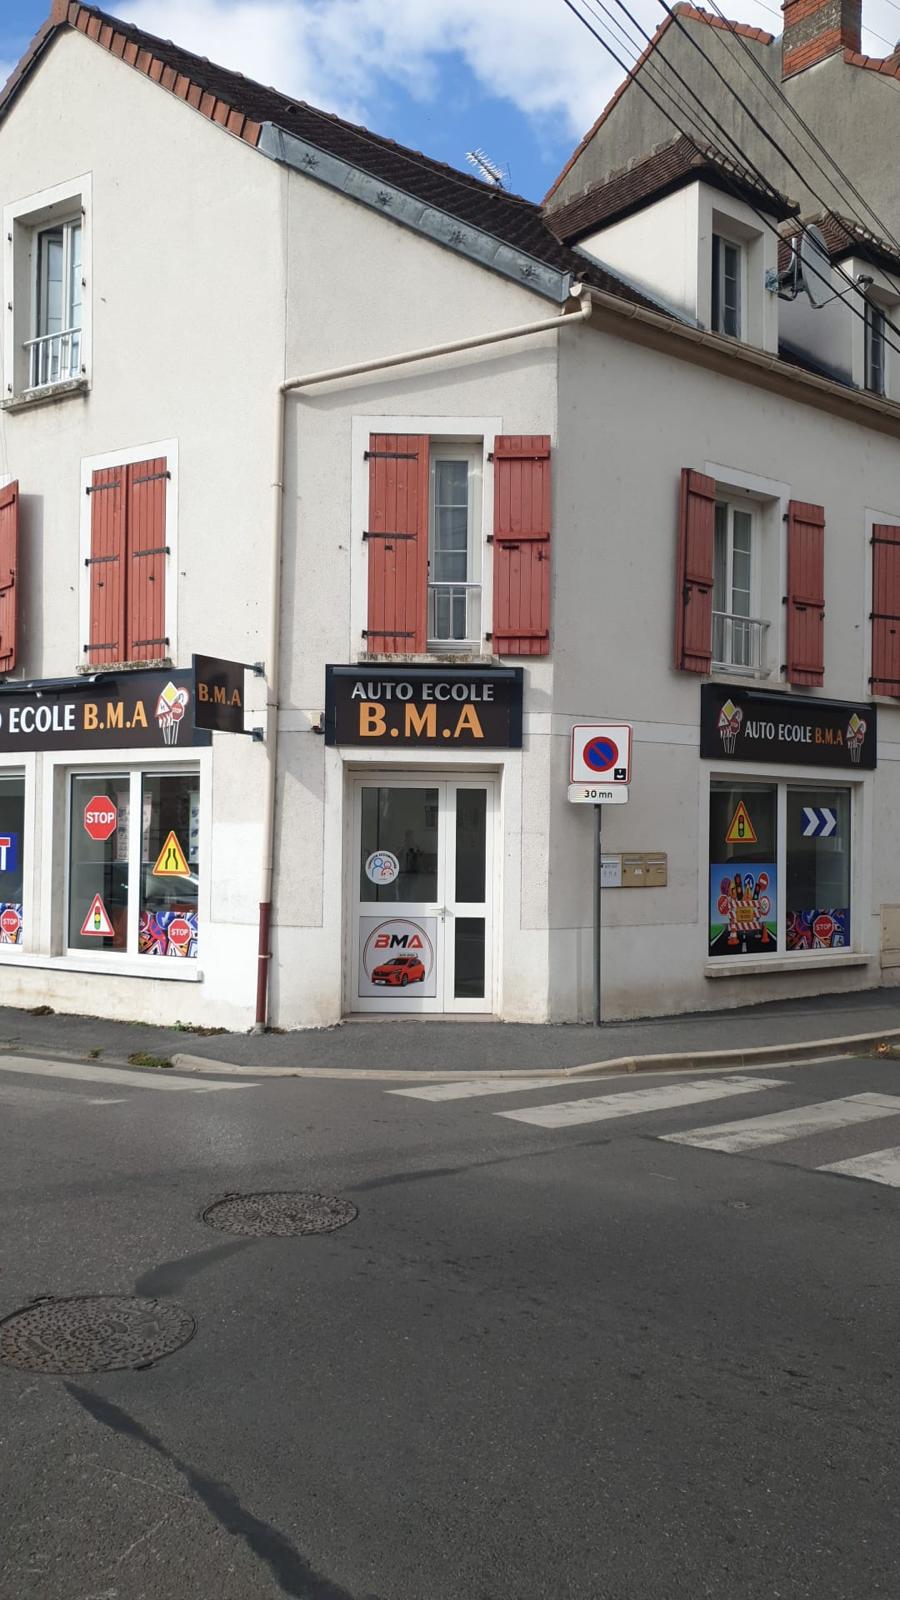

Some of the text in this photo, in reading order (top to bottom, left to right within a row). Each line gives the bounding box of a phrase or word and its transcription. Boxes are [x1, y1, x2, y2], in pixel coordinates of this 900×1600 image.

[198, 682, 241, 707] B.M.A
[351, 682, 494, 701] AUTO ECOLE
[9, 704, 75, 733] ECOLE
[83, 701, 148, 730] B.M.A
[359, 702, 484, 738] B.M.A
[744, 720, 844, 745] AUTO ECOLE B.M.A
[584, 790, 597, 798] 30
[86, 811, 115, 824] STOP
[171, 928, 189, 936] STOP
[374, 934, 424, 949] BMA
